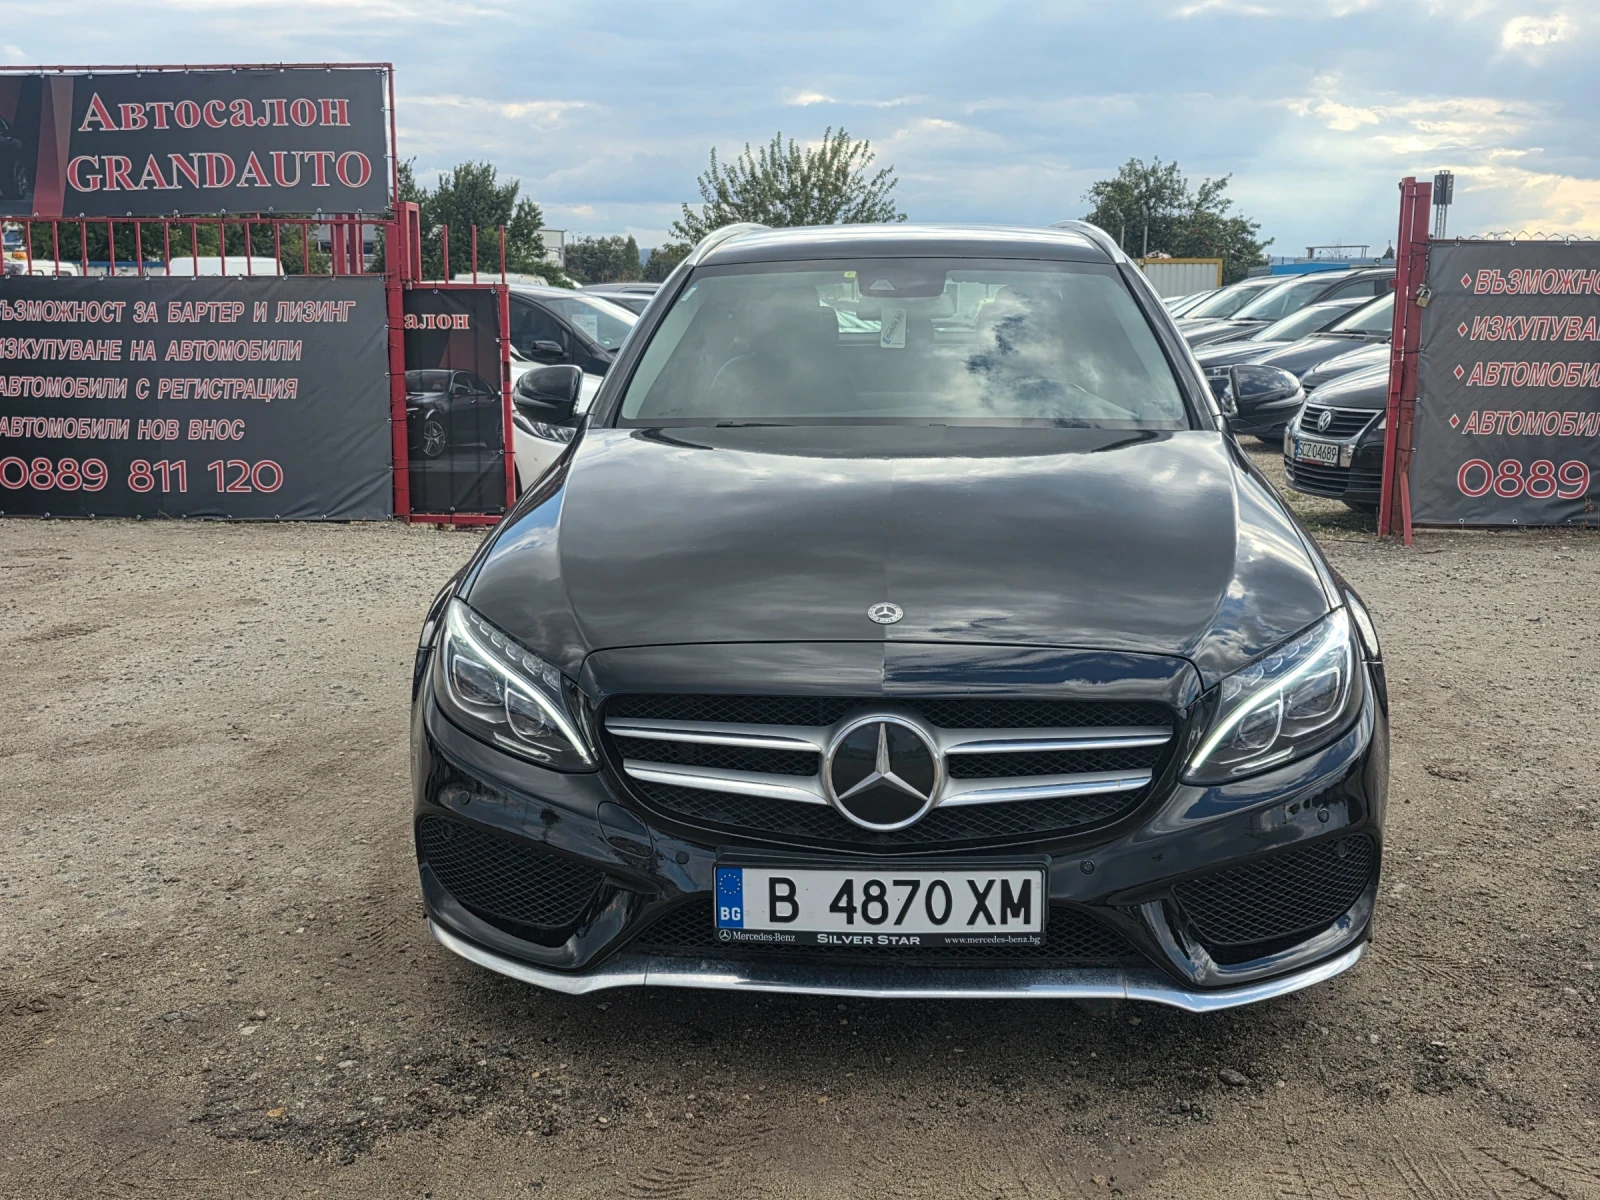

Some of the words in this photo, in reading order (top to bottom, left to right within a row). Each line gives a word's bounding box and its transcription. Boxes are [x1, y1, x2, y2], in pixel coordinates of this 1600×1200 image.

[79, 92, 351, 132] Автосалон
[67, 150, 372, 192] GRANDAUTO
[0, 299, 126, 323] ЪЗМОЖНОСТ
[133, 301, 159, 323] ЗА
[168, 301, 245, 323] БАРТЕР
[253, 301, 268, 323] И
[275, 301, 356, 323] ЛИЗИНГ
[1470, 316, 1600, 341] ИЗКУПУВА
[130, 340, 156, 361] НА
[164, 340, 302, 361] АВТОМОБИЛИ
[1466, 362, 1600, 387] АВТОМОБИ
[136, 378, 150, 400] С
[158, 378, 298, 402] РЕГИСТРАЦИЯ
[0, 416, 130, 440] АВТОМОБИЛИ
[137, 418, 180, 440] НОВ
[188, 418, 245, 440] ВНОС
[1312, 444, 1337, 461] 04689
[0, 457, 108, 491] 0889
[127, 459, 188, 493] 811
[207, 459, 284, 493] 120
[1457, 459, 1590, 499] 0889
[769, 877, 800, 923] B
[829, 879, 953, 926] 4870
[966, 879, 1032, 926] XM
[721, 907, 741, 921] BG
[733, 931, 796, 942] Mercedes-Benz
[817, 933, 874, 945] SILVER
[877, 935, 921, 945] STAR
[944, 934, 1041, 945] www.mercedes-benz.bg
